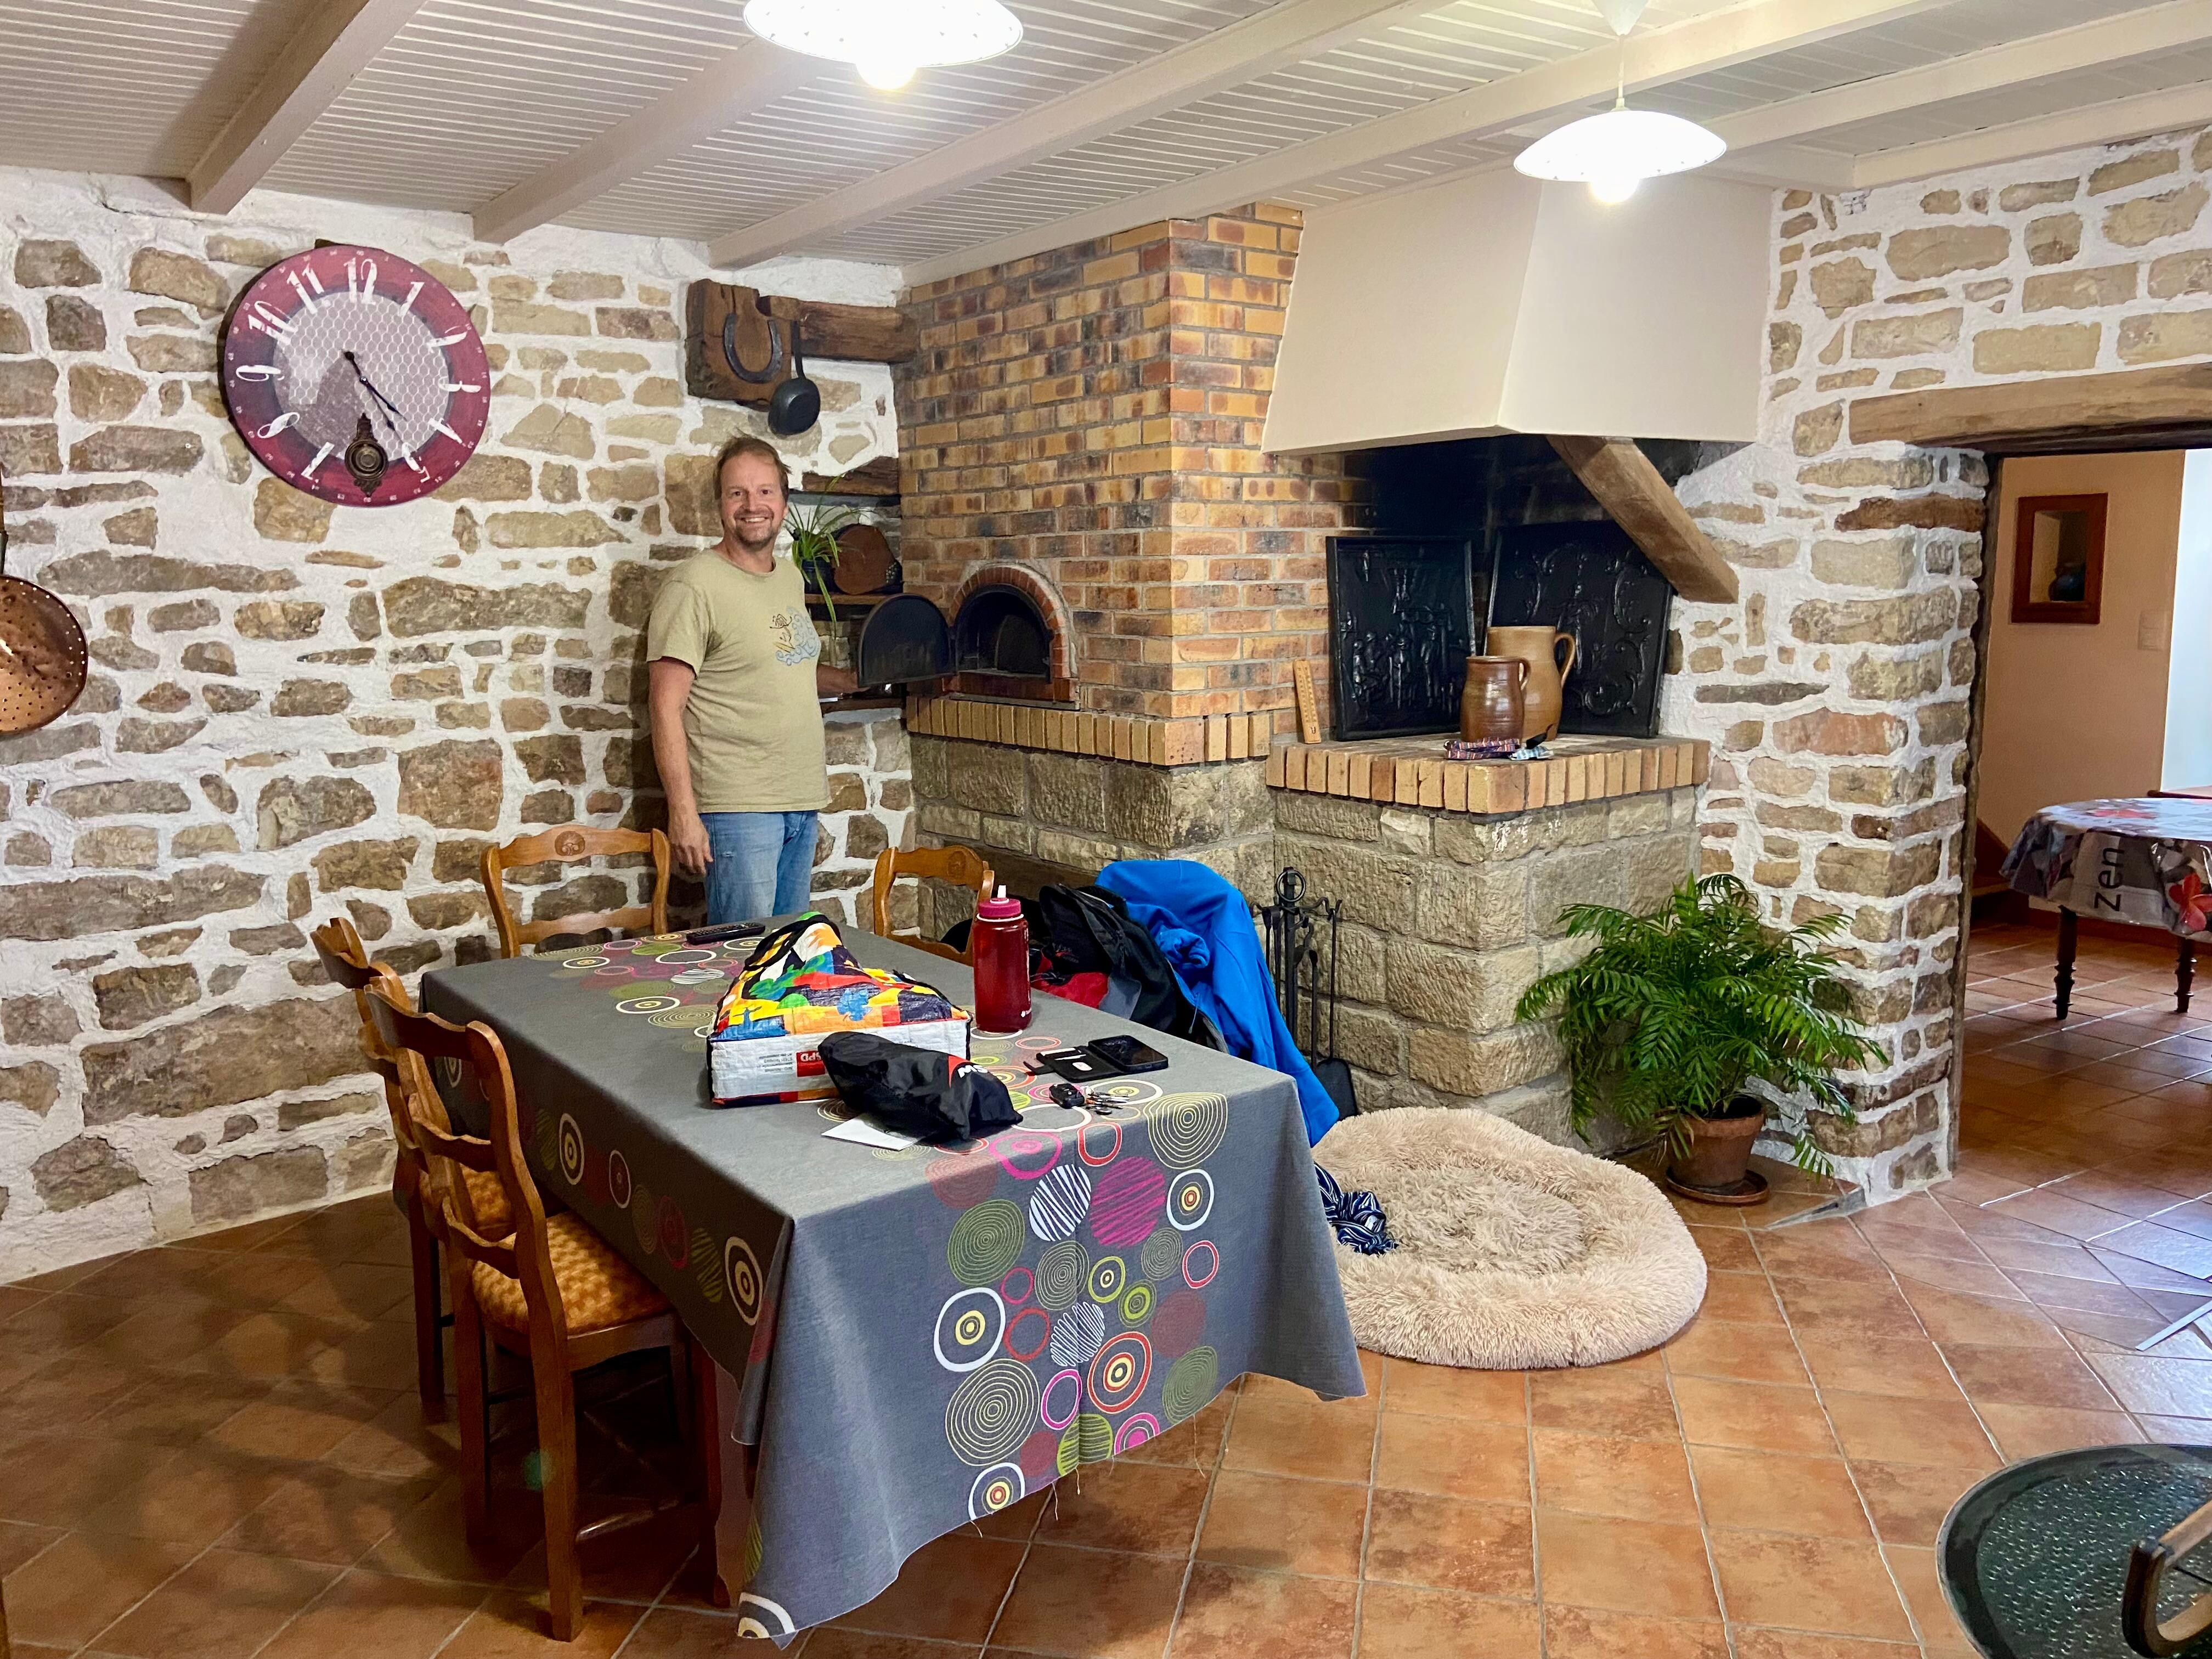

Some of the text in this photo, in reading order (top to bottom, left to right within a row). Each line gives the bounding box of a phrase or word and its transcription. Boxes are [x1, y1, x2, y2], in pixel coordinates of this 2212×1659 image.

[286, 263, 325, 314] 11
[343, 257, 377, 304] 12
[398, 281, 425, 317] 1
[248, 301, 298, 345] 10
[425, 325, 467, 353] 2
[236, 365, 285, 382] 9
[438, 376, 482, 393] 3
[257, 412, 300, 438] 8
[428, 417, 466, 447] 4
[301, 442, 335, 480] 7
[402, 442, 430, 483] 5
